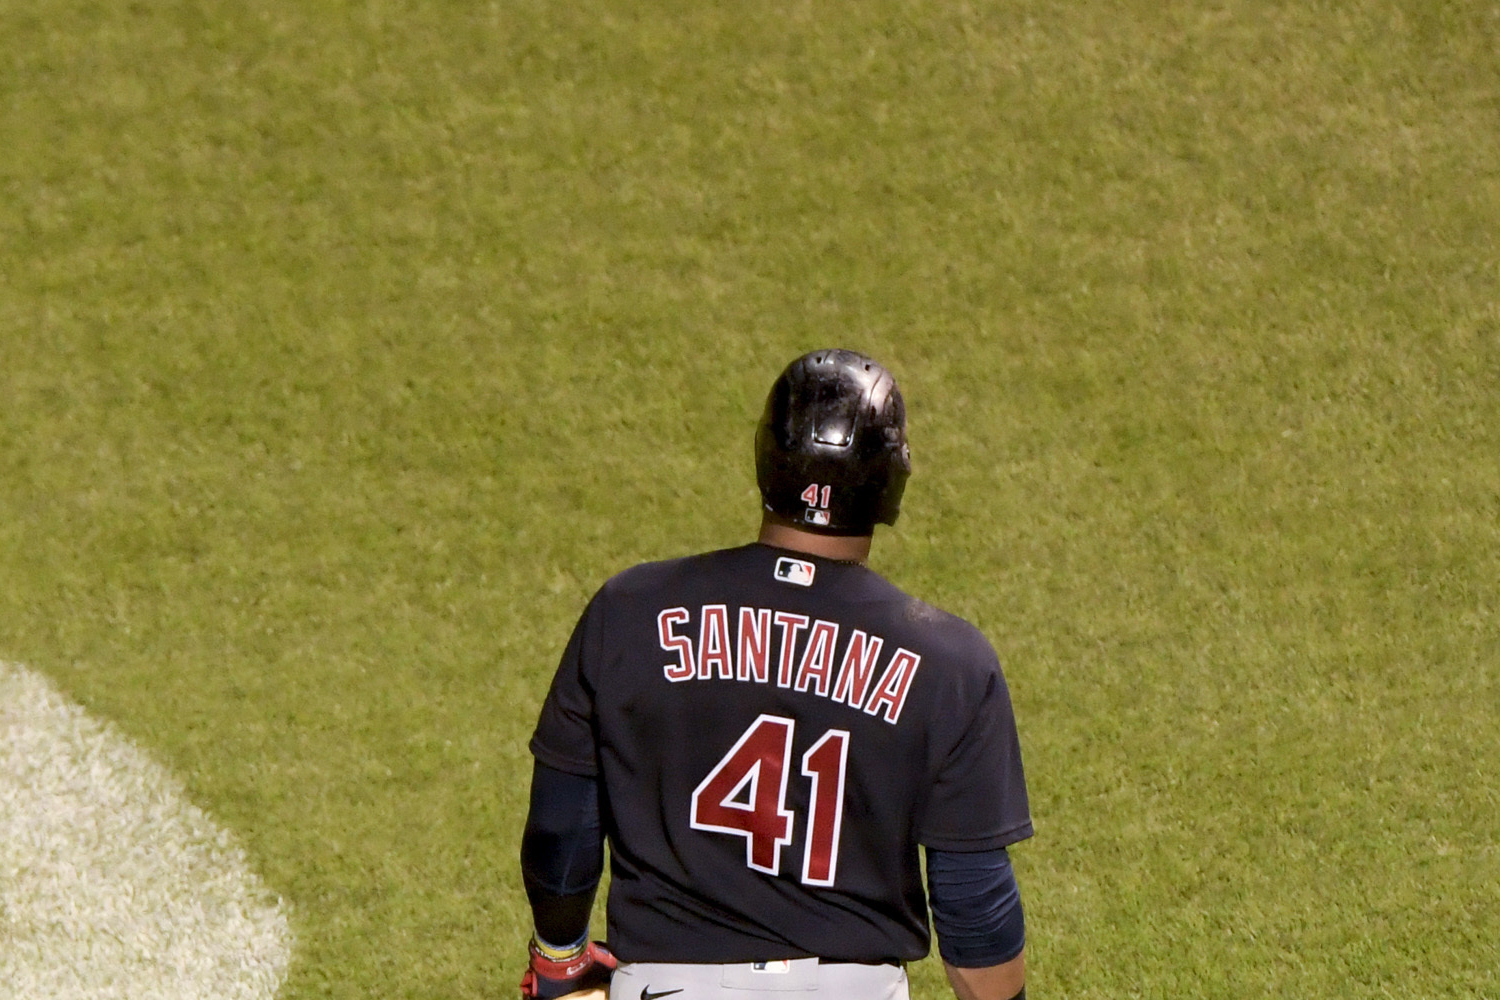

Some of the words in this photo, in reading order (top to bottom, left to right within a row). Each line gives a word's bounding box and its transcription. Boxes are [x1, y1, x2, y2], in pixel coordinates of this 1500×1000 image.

[801, 484, 831, 508] 41
[657, 604, 921, 725] SANTANA
[690, 714, 850, 887] 41
